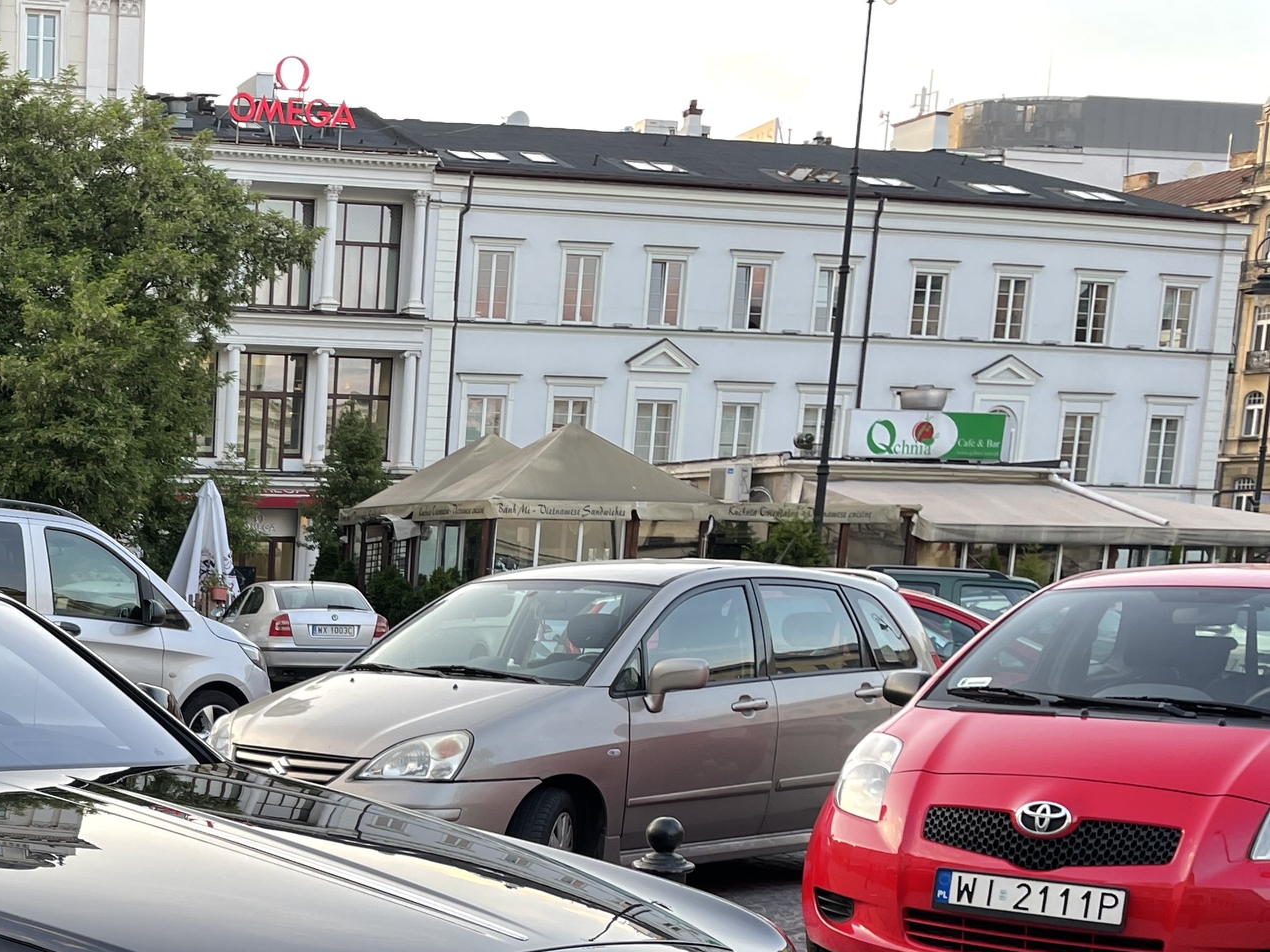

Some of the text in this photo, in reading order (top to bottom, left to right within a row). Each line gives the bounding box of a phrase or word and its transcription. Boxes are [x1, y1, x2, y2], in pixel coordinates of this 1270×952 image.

[229, 91, 356, 129] OMEGA
[867, 419, 931, 455] Qchnia
[958, 438, 1000, 448] Cafe & Bar
[538, 504, 581, 516] Vietnamese
[581, 505, 625, 517] Sandwiches
[937, 890, 949, 900] PL
[956, 875, 1119, 921] WI 2111P
